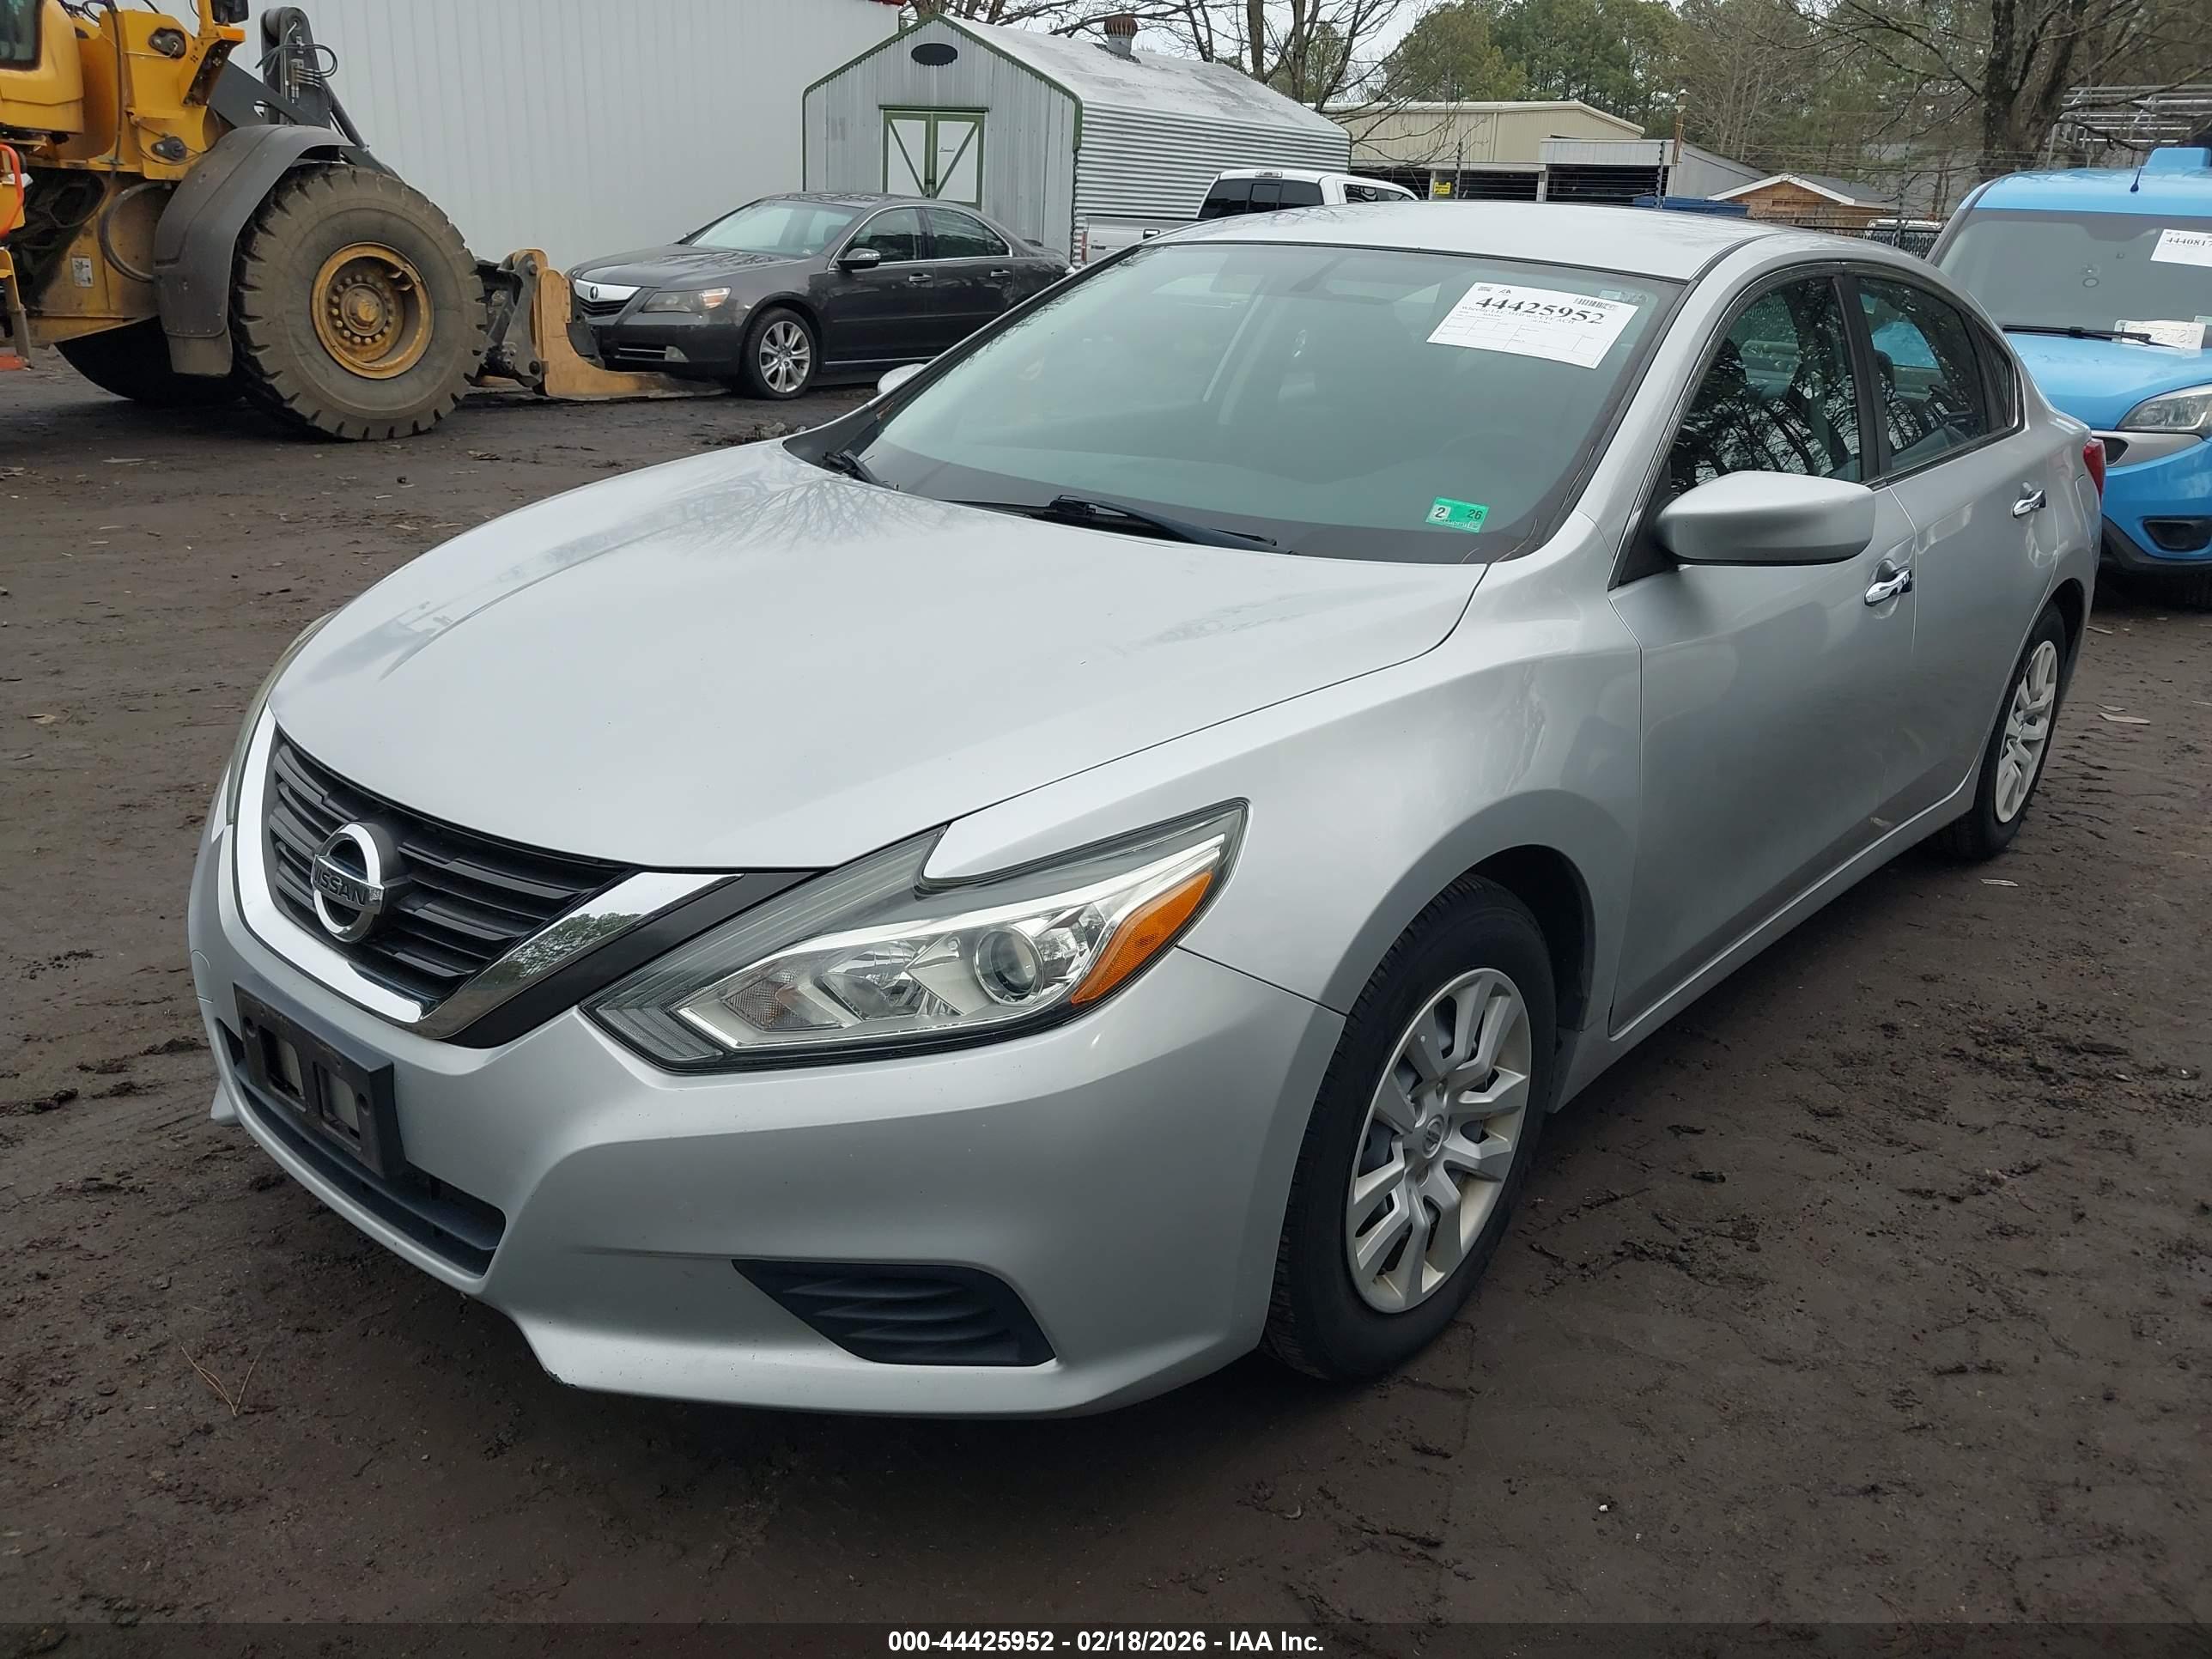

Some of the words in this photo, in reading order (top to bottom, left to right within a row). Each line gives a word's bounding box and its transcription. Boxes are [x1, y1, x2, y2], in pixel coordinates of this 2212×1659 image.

[1475, 297, 1606, 325] 44425952
[1435, 507, 1446, 518] 2
[1467, 508, 1483, 520] 26
